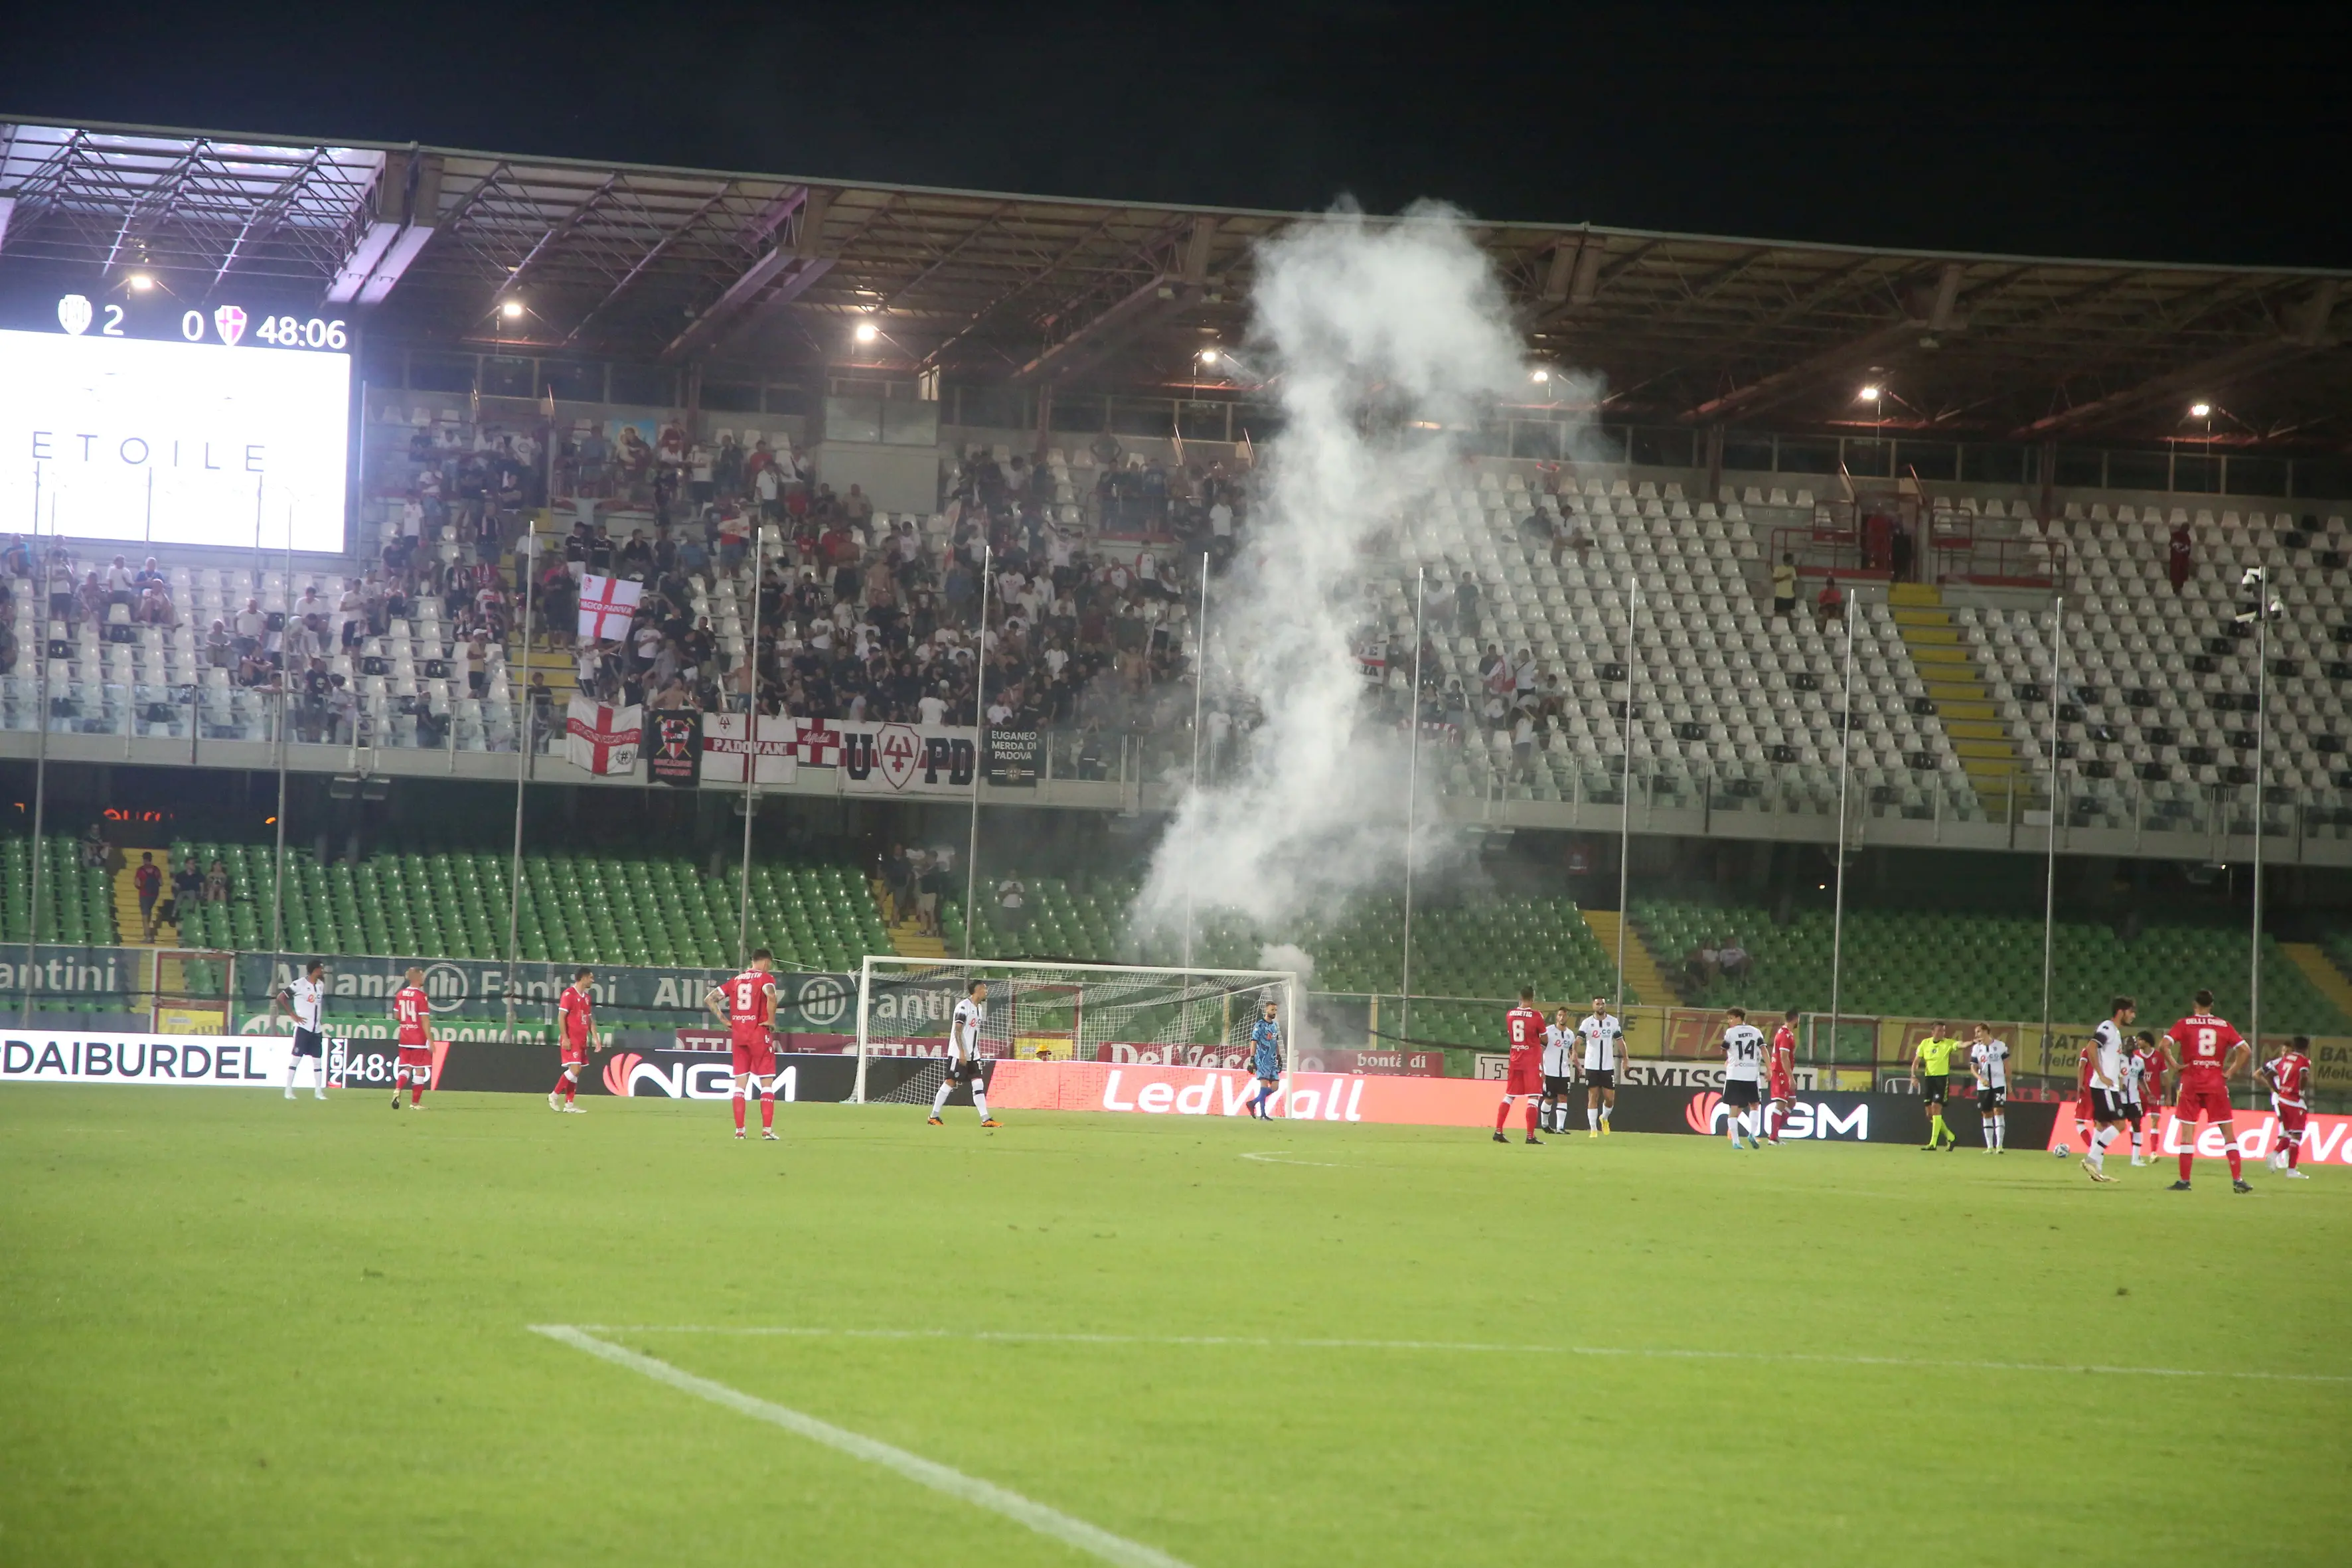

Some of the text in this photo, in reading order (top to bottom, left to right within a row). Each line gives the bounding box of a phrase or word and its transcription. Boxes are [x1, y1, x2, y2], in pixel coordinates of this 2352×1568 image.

[103, 305, 347, 349] 2 0 48:06
[33, 431, 265, 472] ETOILE
[713, 738, 787, 755] PADOVANI
[991, 730, 1037, 741] EUGANEO
[991, 740, 1024, 750] MERDA
[994, 751, 1032, 761] PADOVA
[399, 999, 417, 1022] 14
[1735, 1039, 1755, 1060] 14
[2198, 1028, 2217, 1057] 2
[1410, 1055, 1427, 1068] di
[627, 1061, 797, 1102] NGM
[2282, 1062, 2294, 1085] 7
[1103, 1069, 1364, 1122] LedWall
